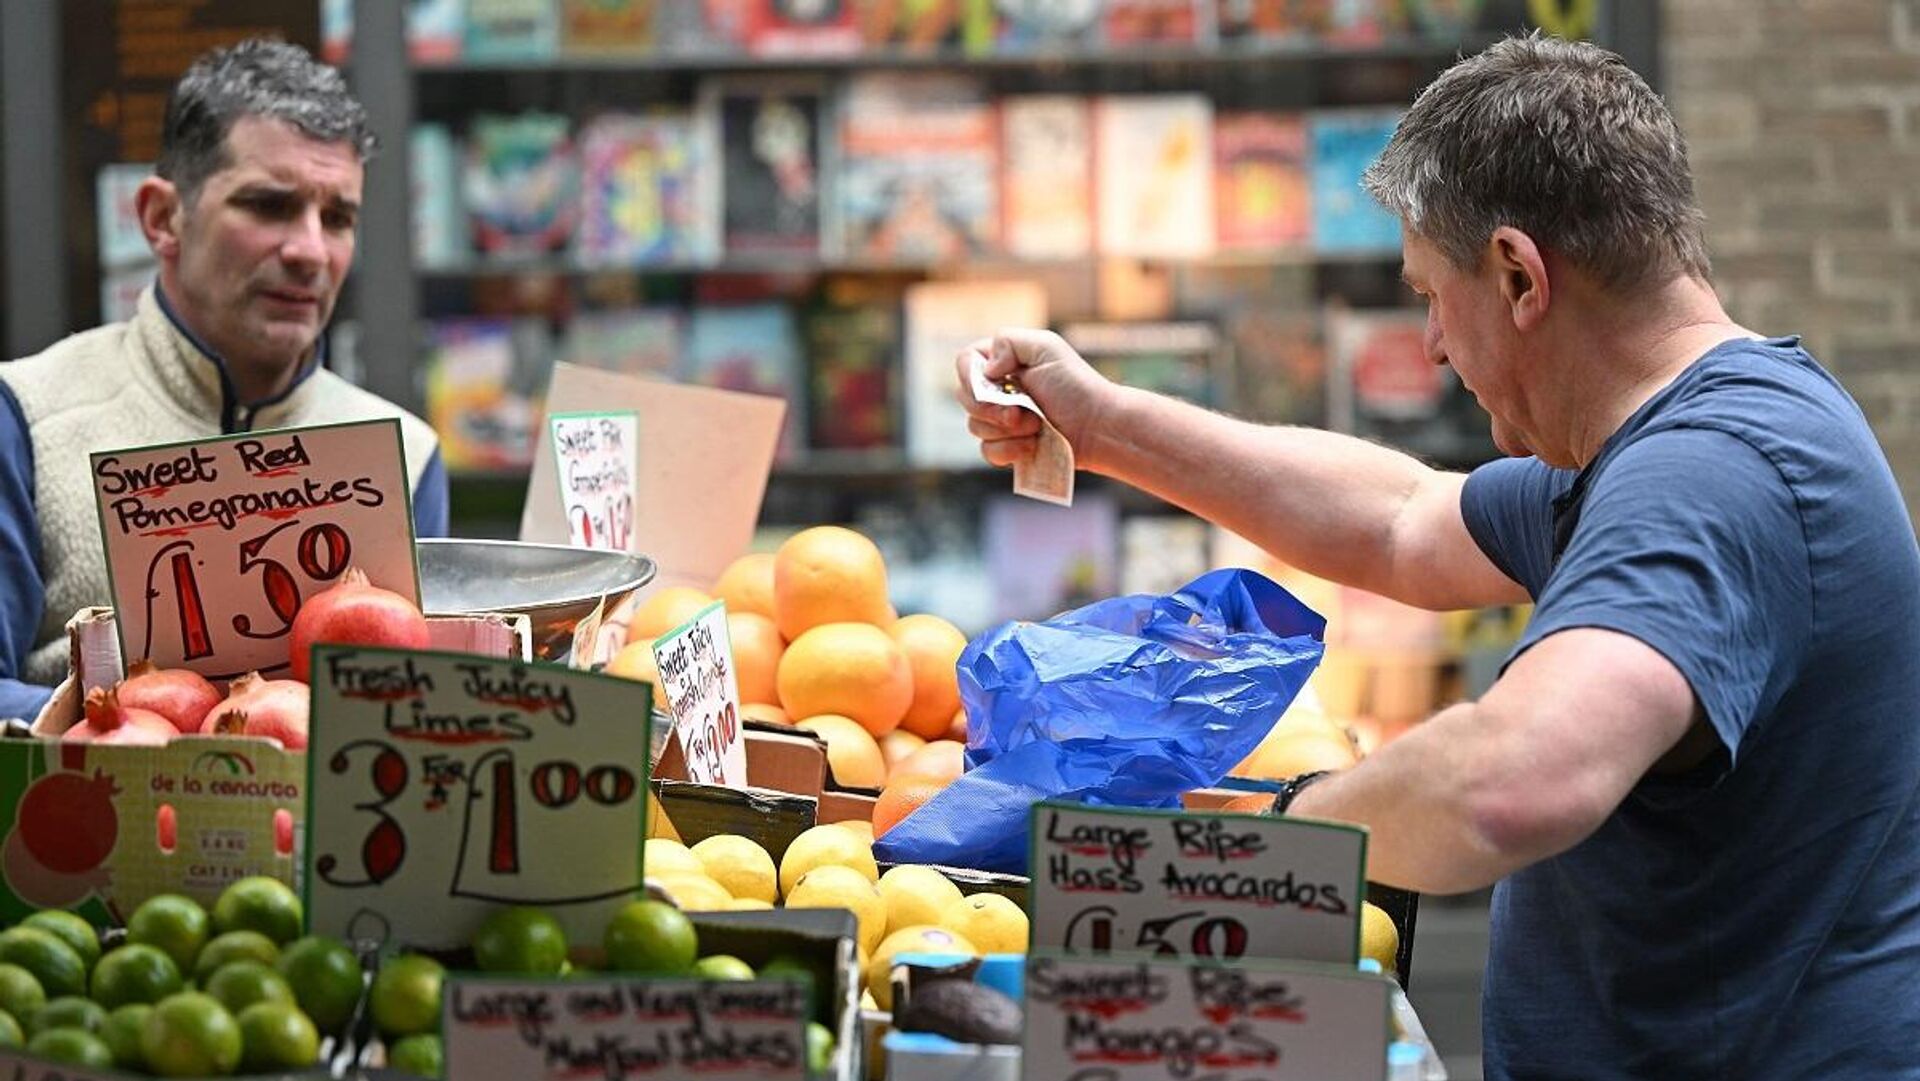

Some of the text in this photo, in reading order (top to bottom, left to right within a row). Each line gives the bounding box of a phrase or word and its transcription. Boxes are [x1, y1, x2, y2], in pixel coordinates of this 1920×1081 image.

[96, 435, 310, 494] Sweet Red
[110, 477, 384, 535] Pomegranates
[656, 637, 690, 680] Sweet
[326, 654, 576, 726] Fresh Juicy
[385, 702, 533, 741] Limes
[151, 773, 175, 793] de
[183, 775, 203, 795] la
[316, 739, 409, 888] 3
[1046, 813, 1267, 866] Large Ripe
[1050, 854, 1144, 894] Hass
[452, 983, 553, 1046] Large
